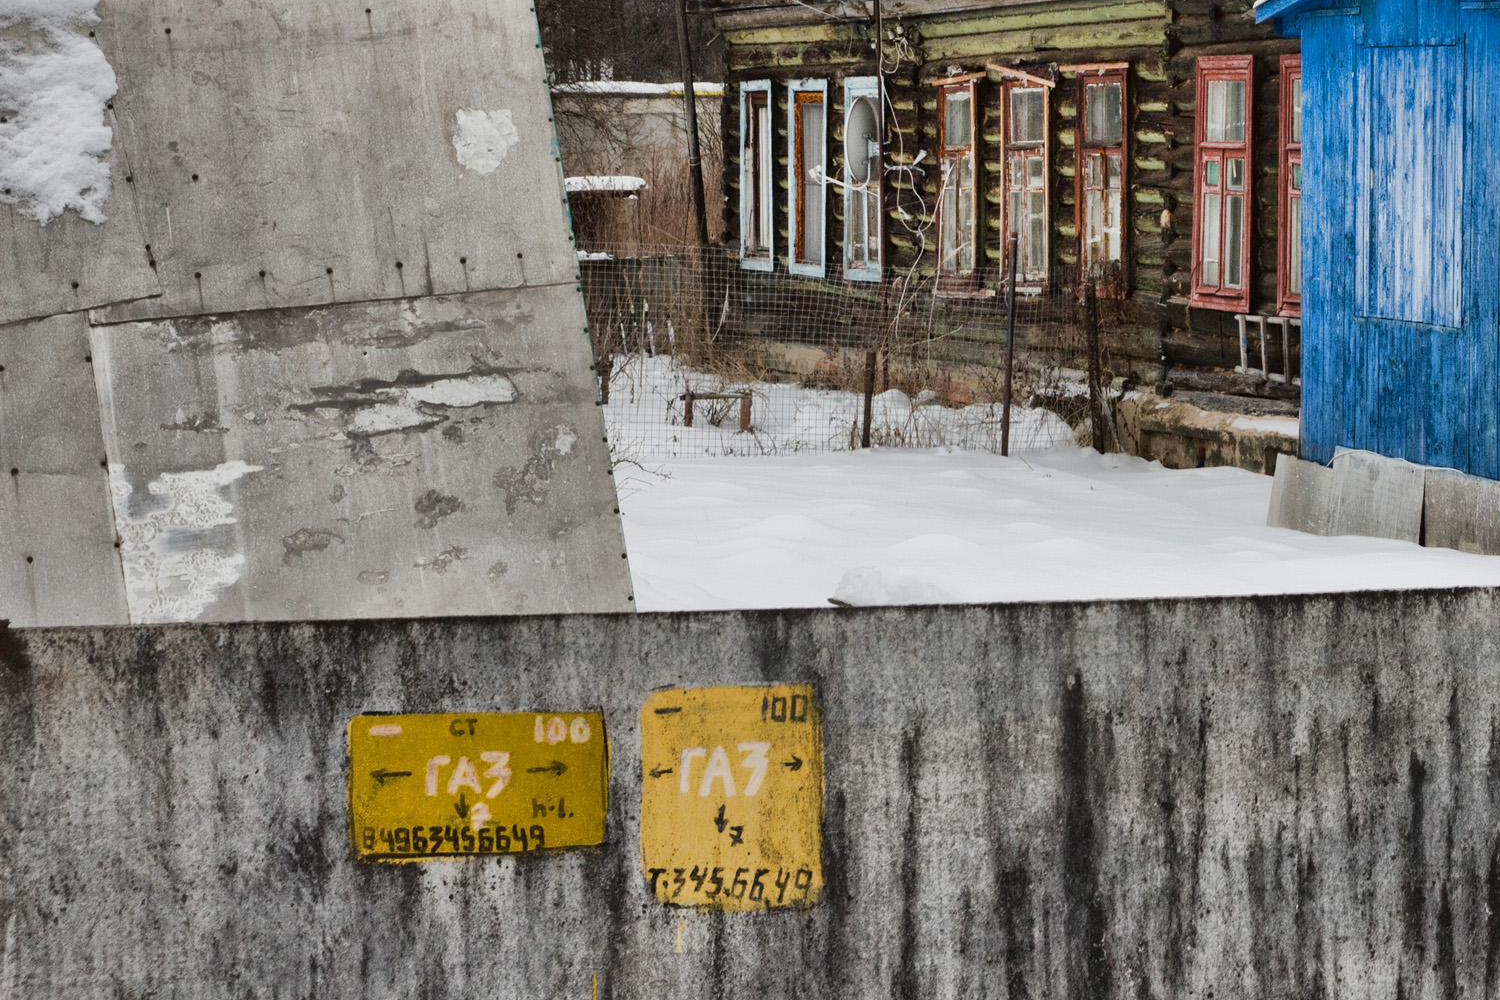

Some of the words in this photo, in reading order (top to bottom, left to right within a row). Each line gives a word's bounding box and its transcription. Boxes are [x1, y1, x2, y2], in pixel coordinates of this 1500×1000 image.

[761, 694, 808, 722] 100
[534, 716, 591, 744] 100
[425, 751, 512, 799] ГАЗ
[679, 741, 771, 797] ГАЗ
